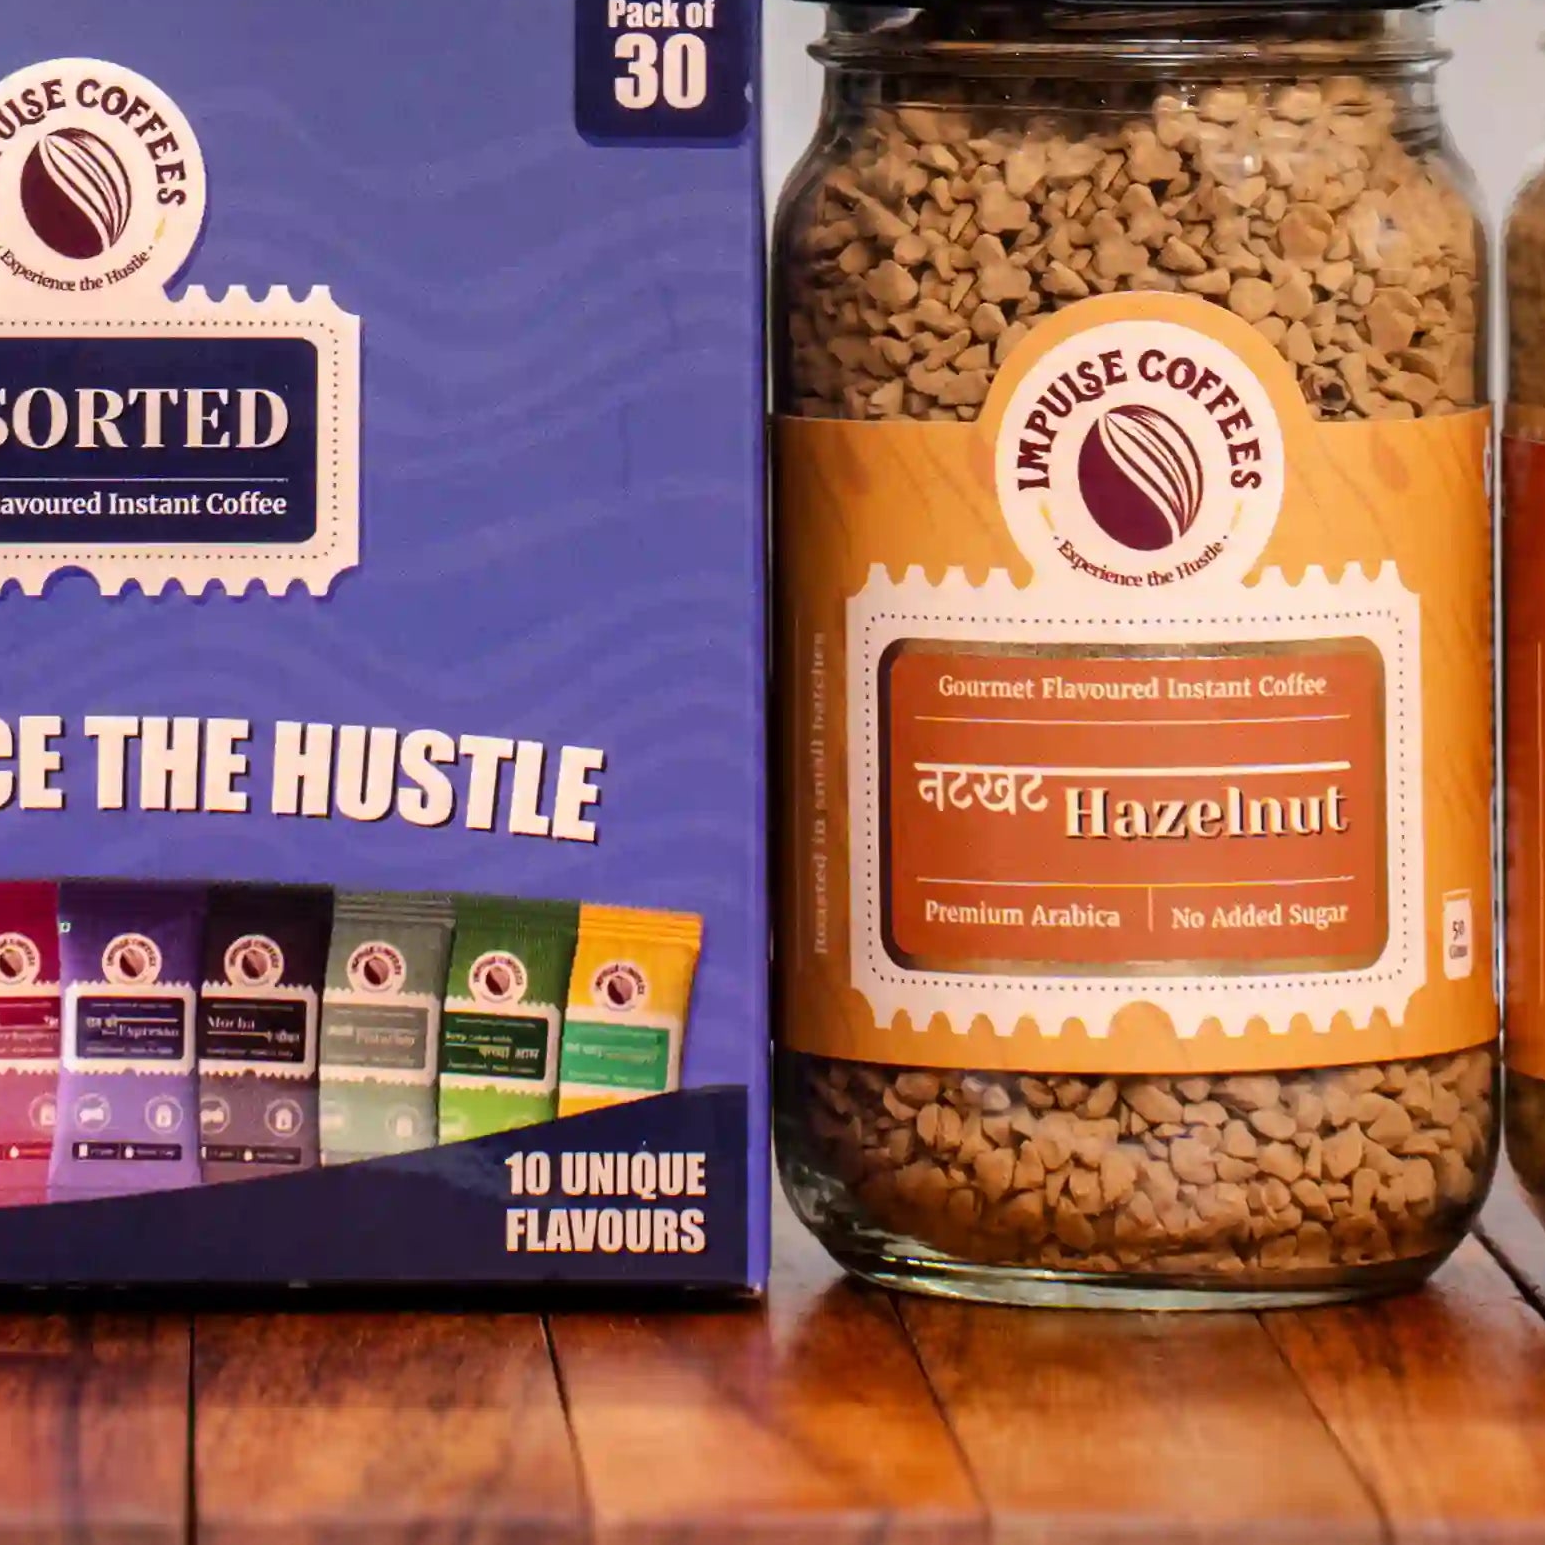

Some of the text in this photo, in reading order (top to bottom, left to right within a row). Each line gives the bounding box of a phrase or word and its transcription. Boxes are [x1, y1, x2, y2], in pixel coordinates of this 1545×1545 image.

[614, 32, 707, 109] 30
[76, 78, 187, 208] COFFEES
[0, 248, 150, 292] Experience the Hustle
[1017, 348, 1262, 491] IMPULSE COFFEES
[108, 493, 200, 516] Instant
[206, 492, 287, 516] Coffee
[1056, 539, 1225, 588] Experience the Hustle
[938, 674, 1327, 701] Gourmet Flavoured Instant Coffee
[83, 716, 249, 812] THE
[271, 721, 604, 842] HUSTLE
[915, 761, 1049, 816] नटखट
[1064, 781, 1350, 842] Hazelnut
[924, 900, 1120, 929] Premium Arabica
[1171, 900, 1348, 930] No Added Sugar
[505, 1151, 707, 1201] 10 UNIQUE
[505, 1208, 706, 1253] FLAVOURS
